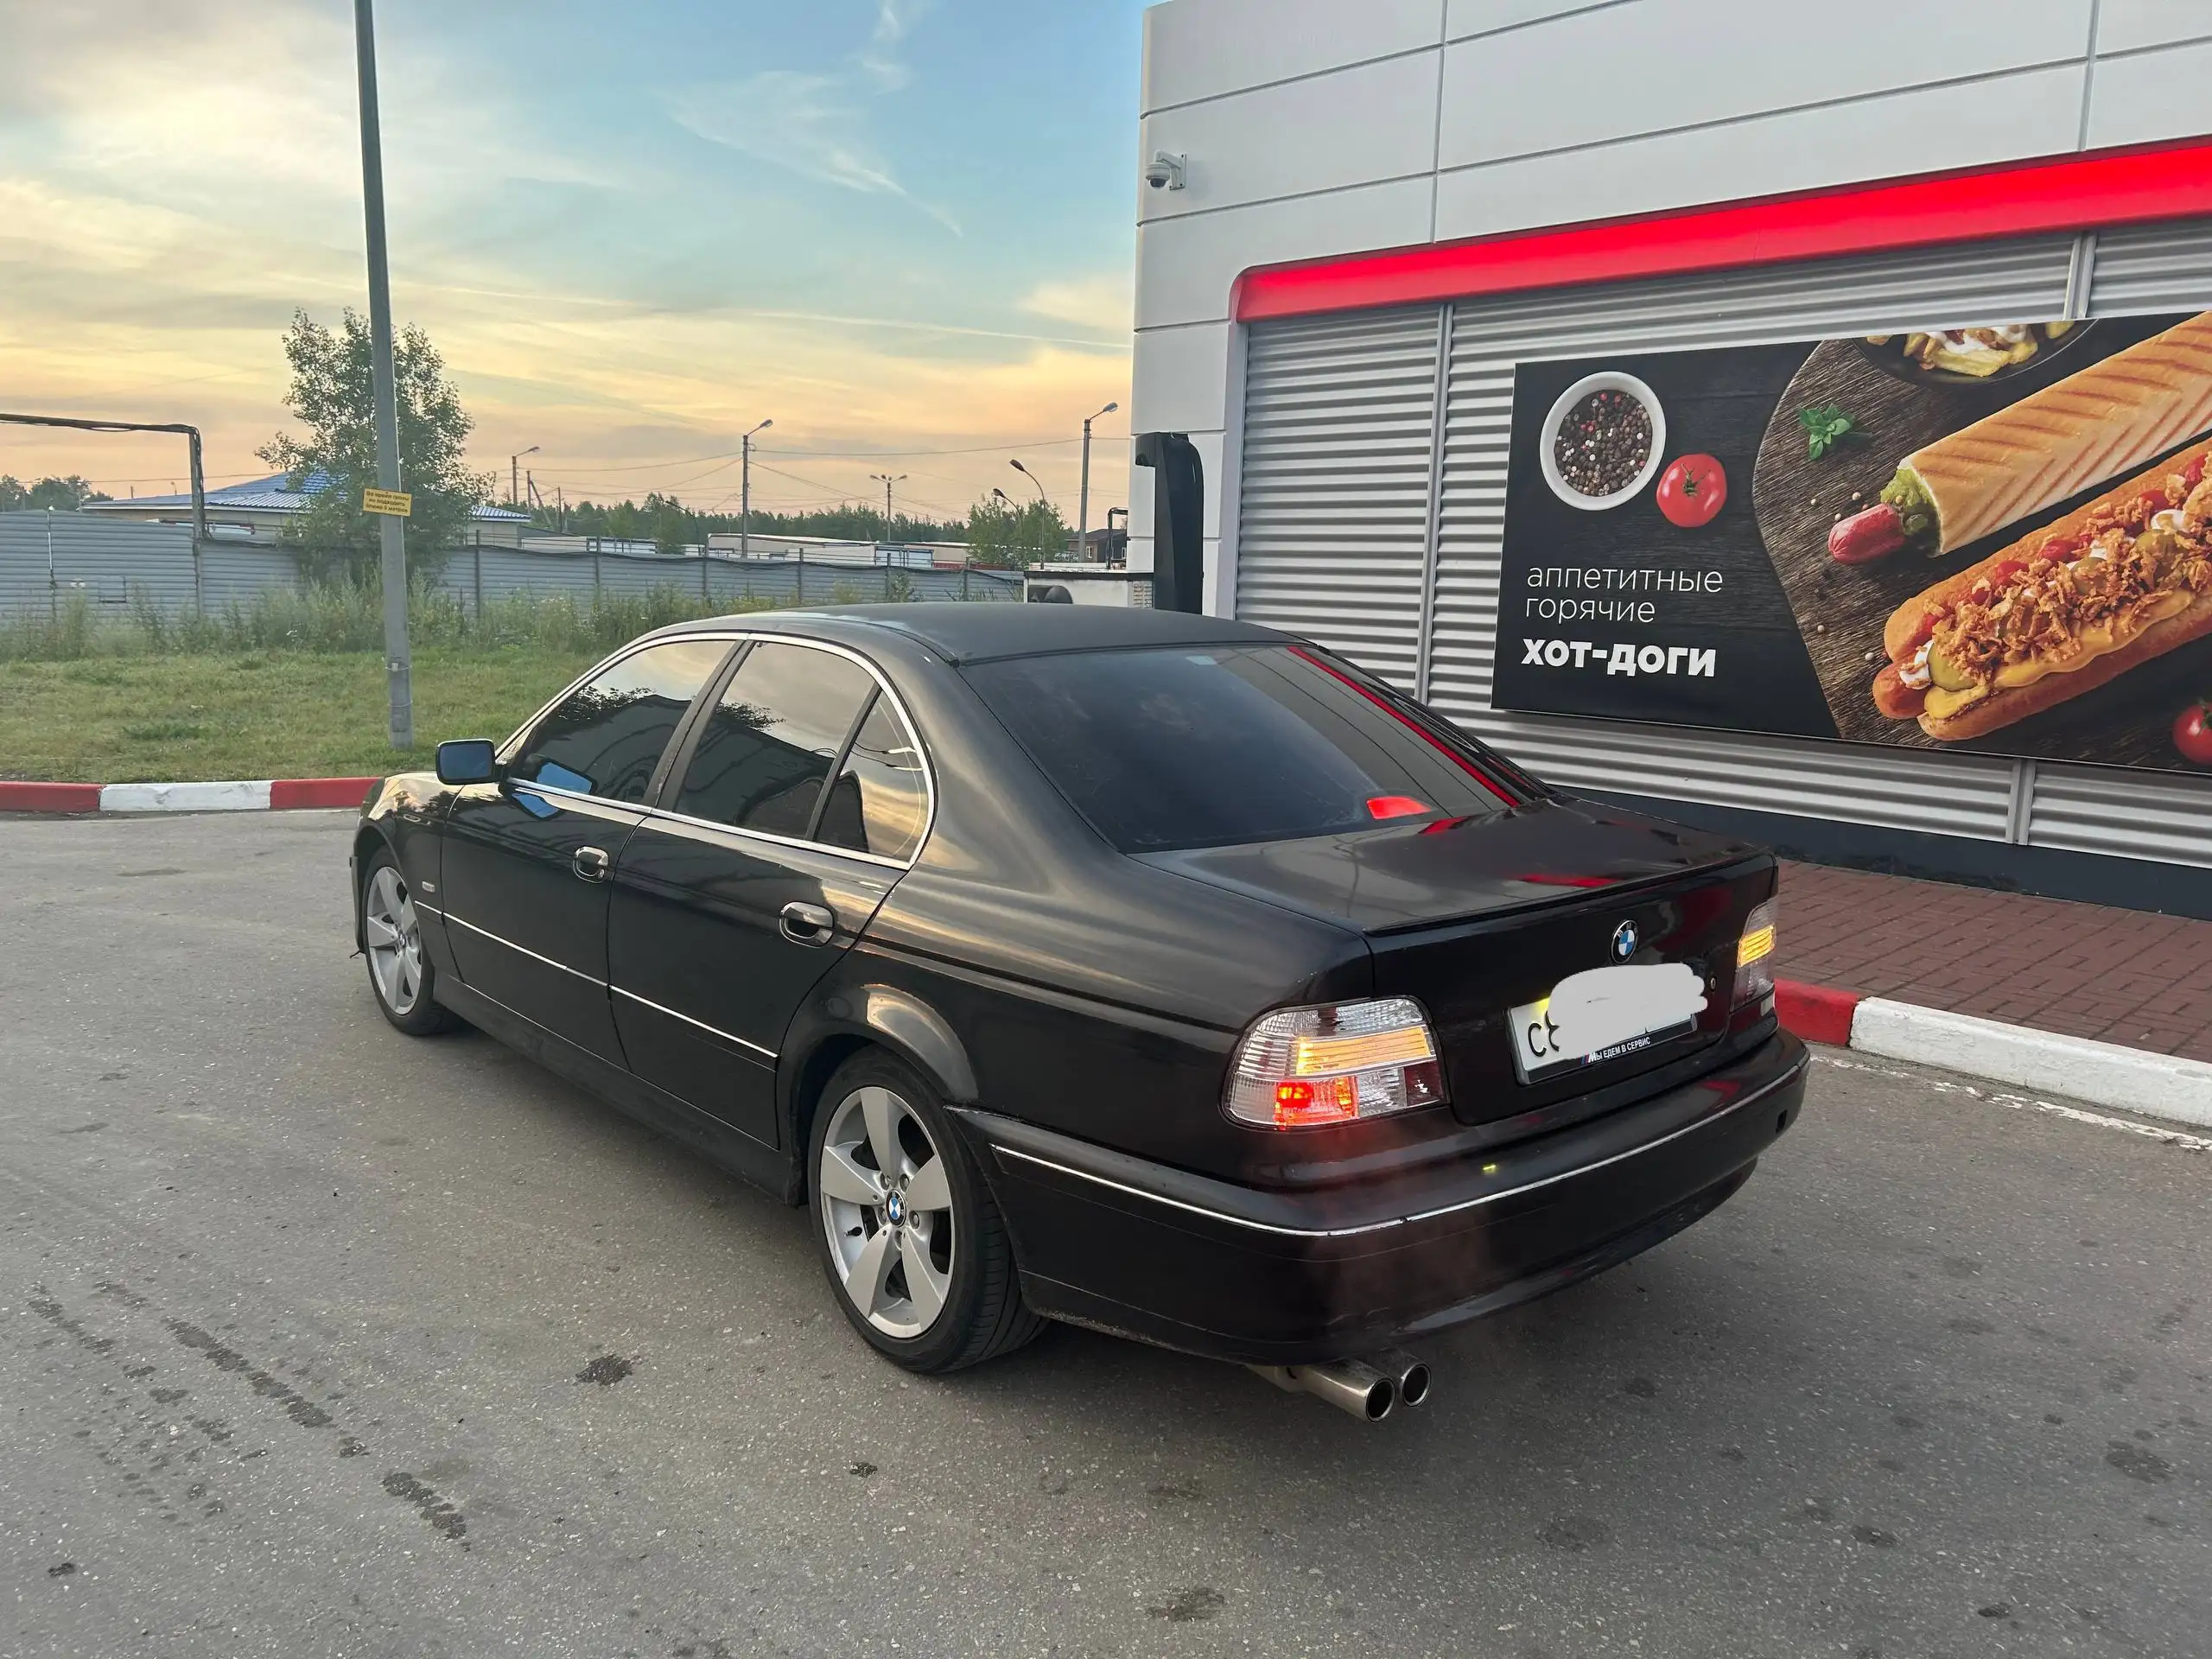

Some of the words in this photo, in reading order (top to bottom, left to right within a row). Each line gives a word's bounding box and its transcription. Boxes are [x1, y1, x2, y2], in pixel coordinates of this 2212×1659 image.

[1527, 566, 1723, 594] аппетитные
[1525, 597, 1656, 625] горячие
[1603, 1045, 1622, 1058] ЕДЕМ
[1621, 1044, 1627, 1052] В
[1626, 1036, 1651, 1051] СЕРВИС
